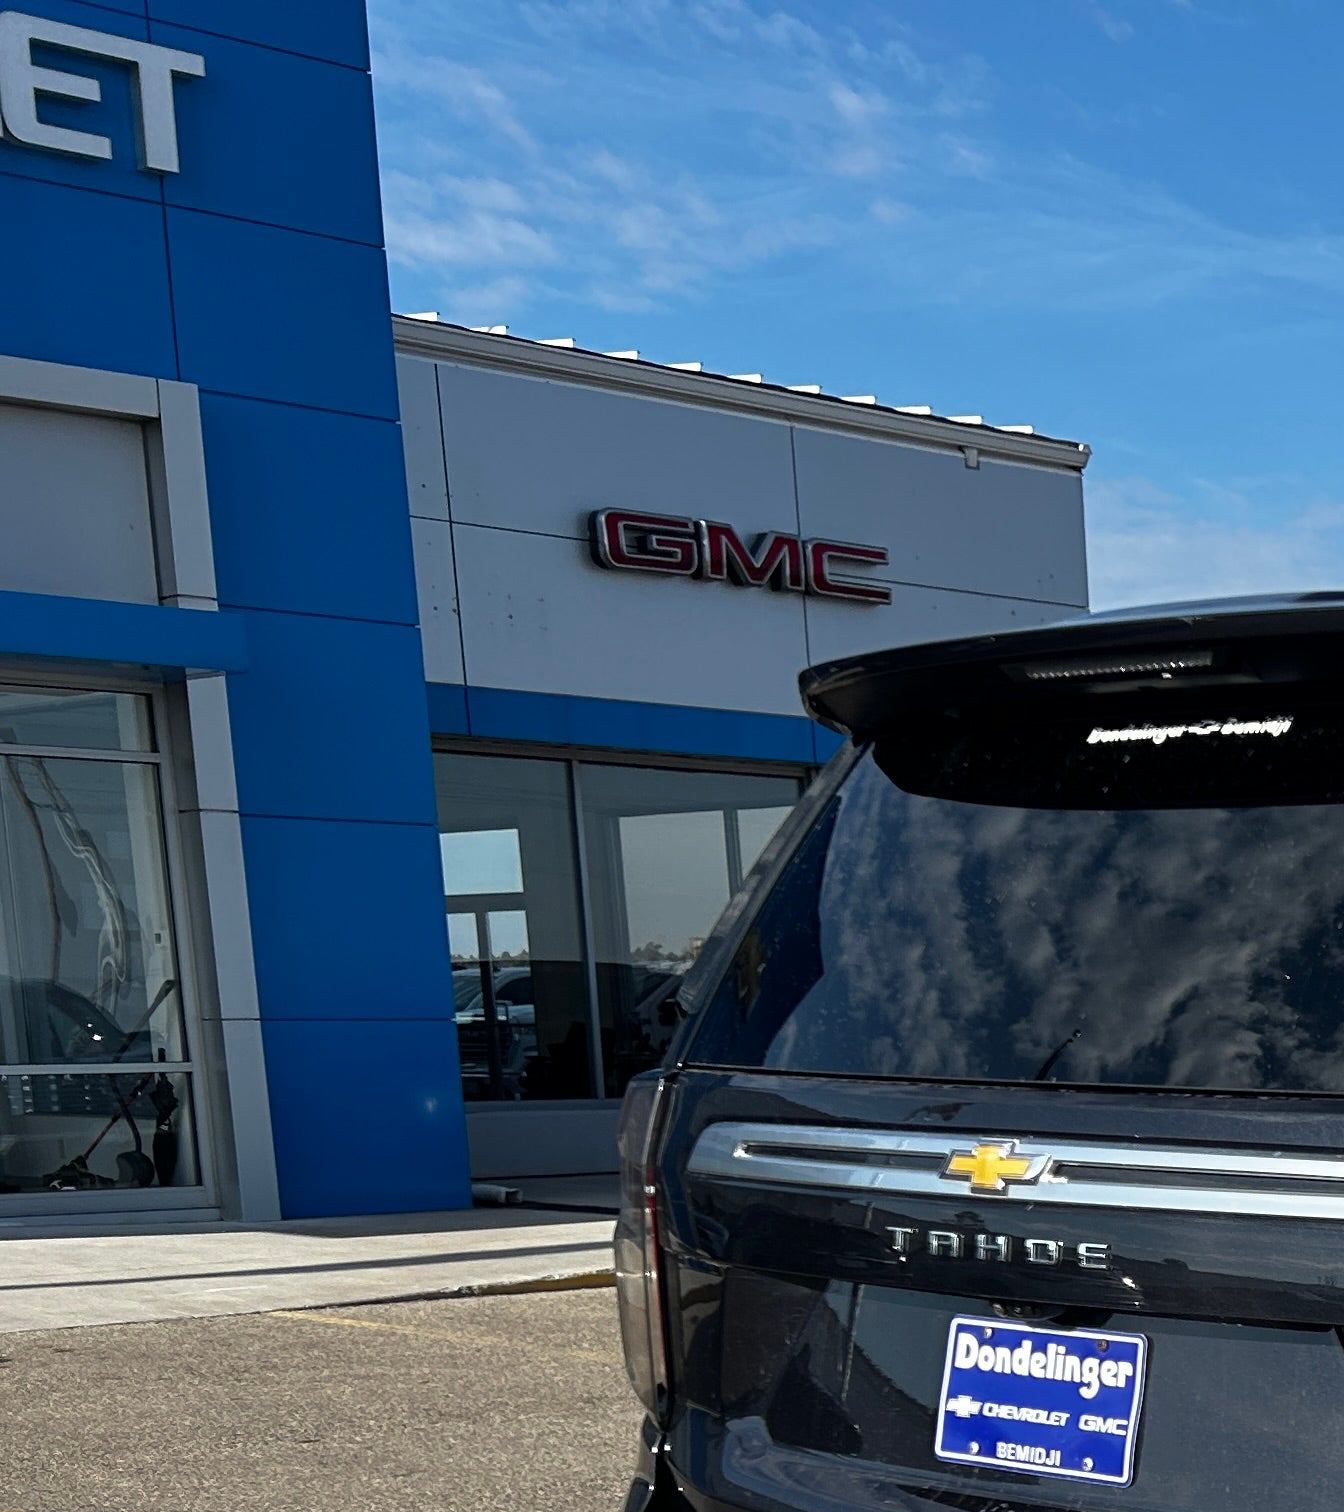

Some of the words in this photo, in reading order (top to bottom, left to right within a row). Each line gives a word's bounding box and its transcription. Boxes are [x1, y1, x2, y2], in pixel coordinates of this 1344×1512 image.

[0, 10, 206, 174] ET
[590, 507, 892, 606] GMC
[884, 1225, 1112, 1270] TAHOE
[953, 1332, 1134, 1400] Dondelinger
[982, 1402, 1071, 1427] CHEVROLET
[1078, 1414, 1129, 1436] GMC
[995, 1441, 1062, 1467] BEMIDJI
